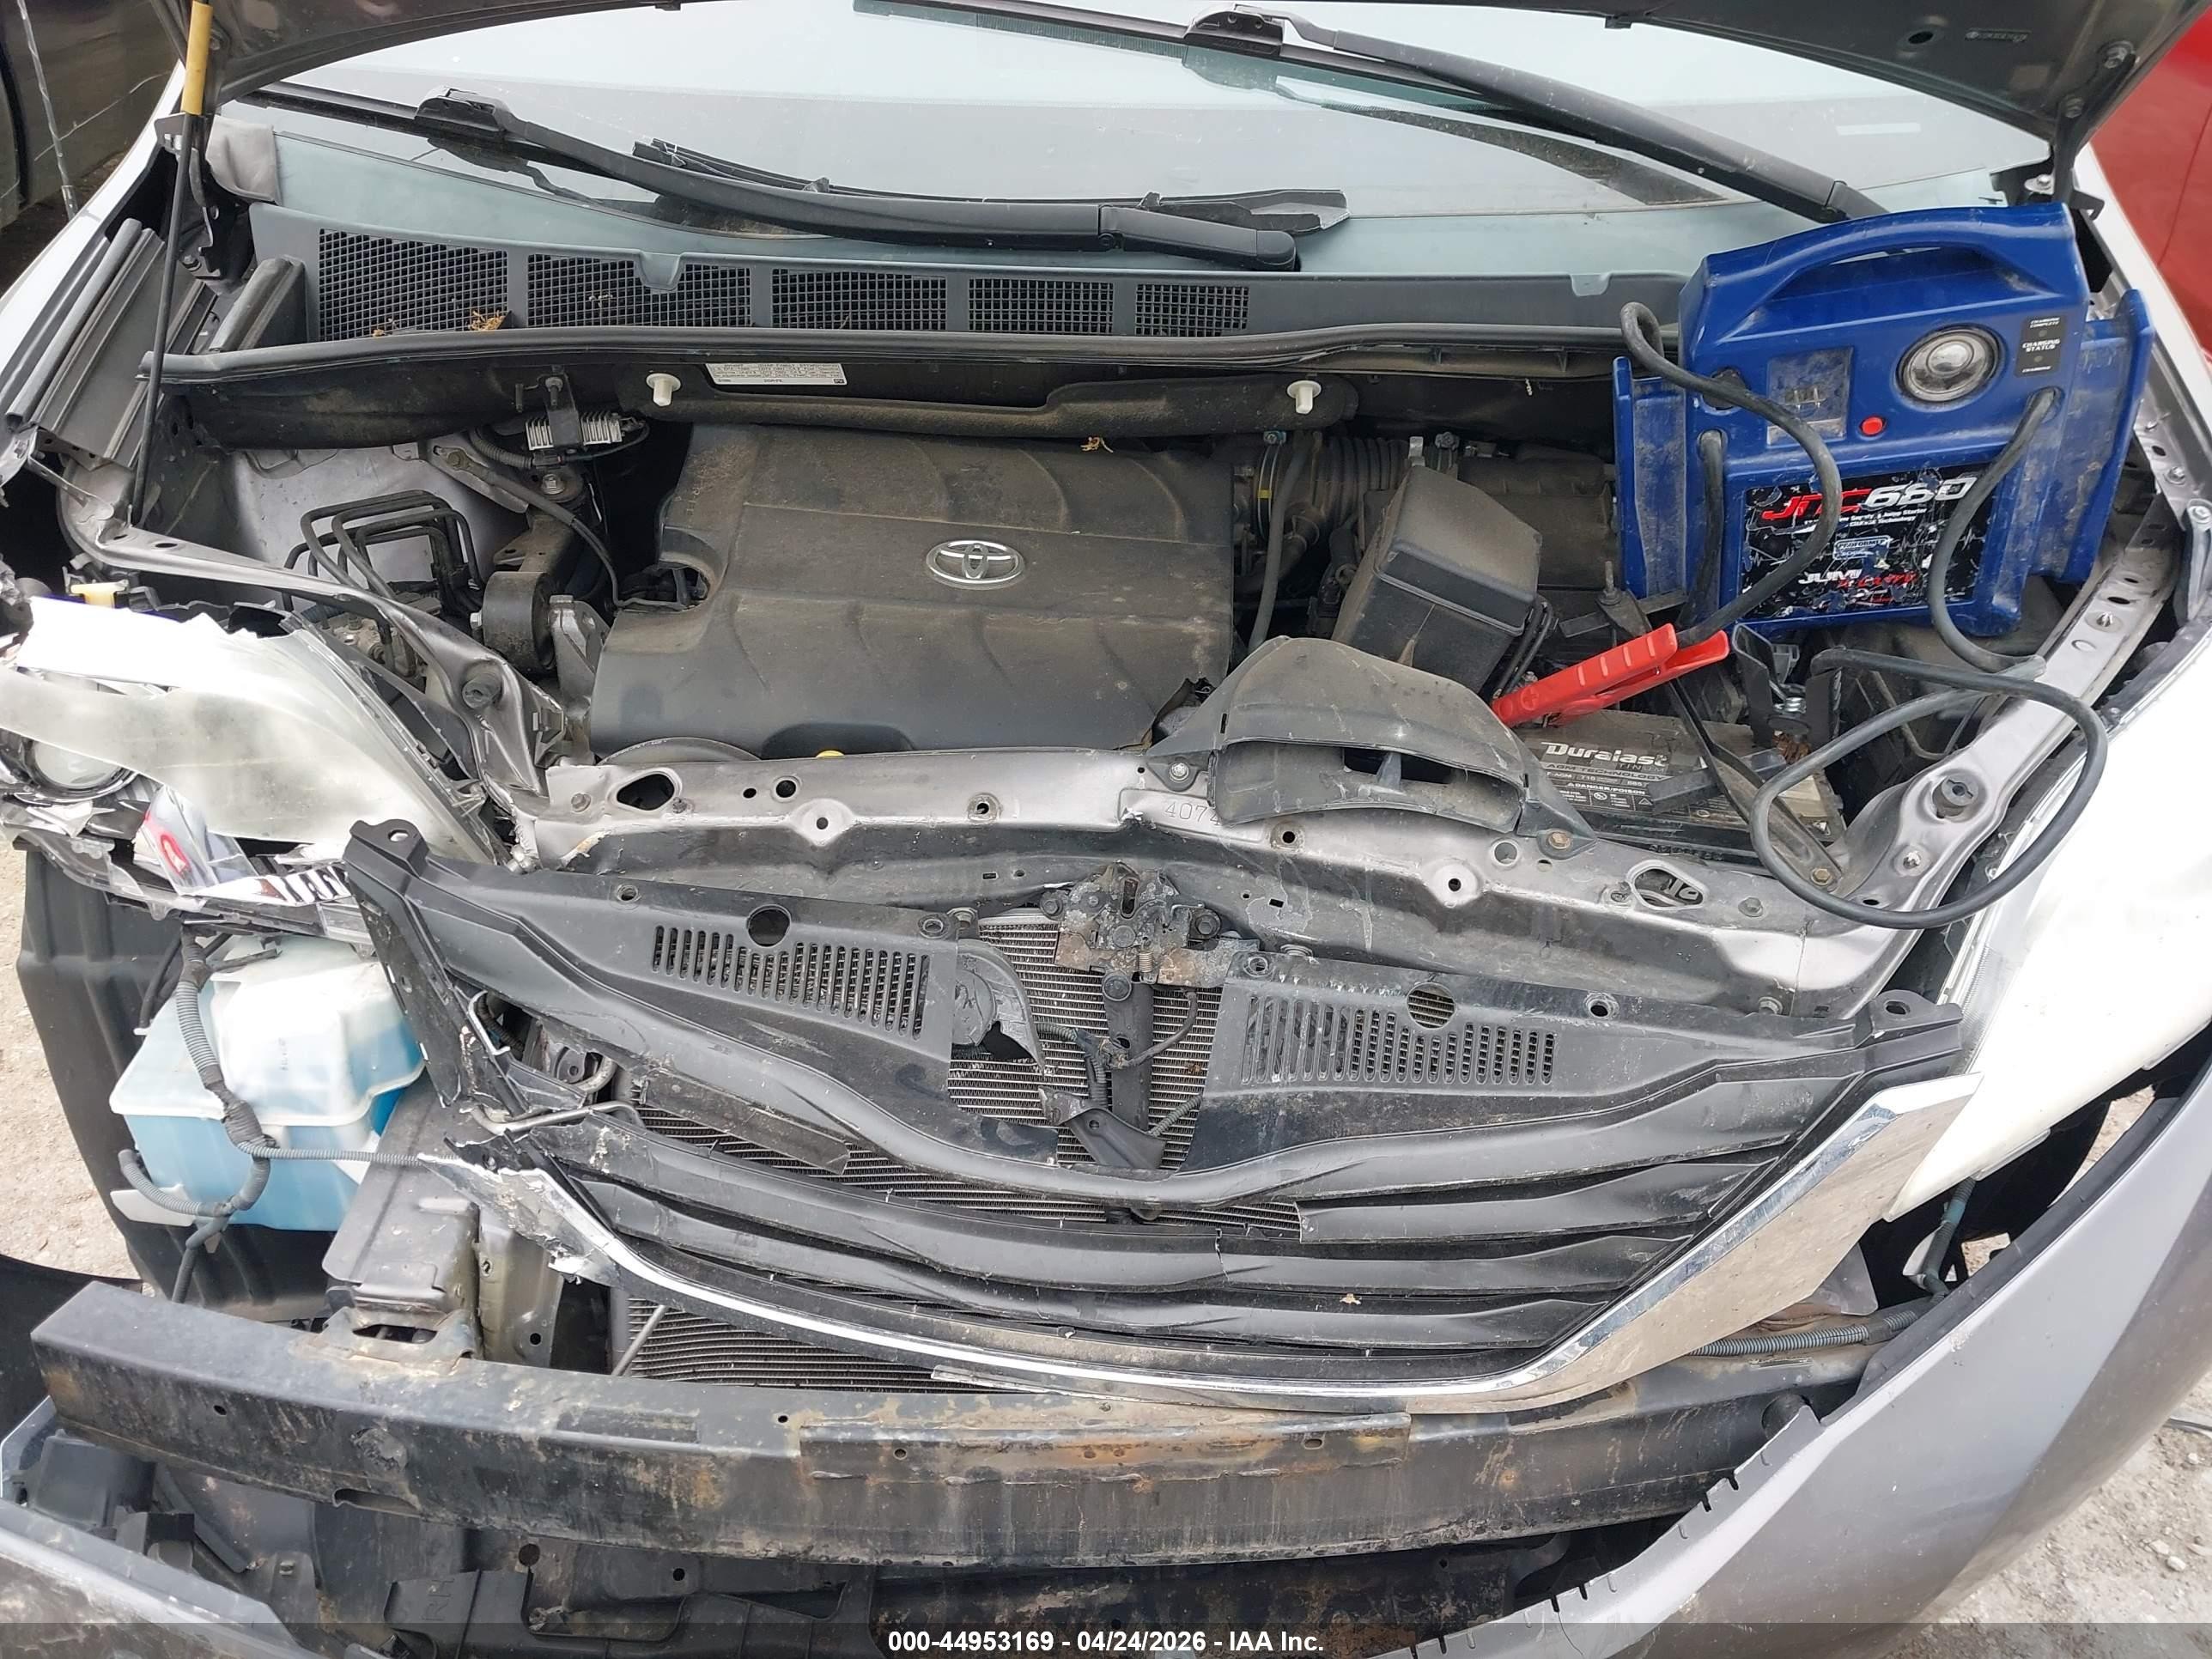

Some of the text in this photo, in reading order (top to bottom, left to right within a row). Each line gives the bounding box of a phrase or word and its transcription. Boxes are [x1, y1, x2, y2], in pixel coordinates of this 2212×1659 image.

[2022, 339, 2060, 349] CHARGING
[1903, 507, 1928, 516] Starter
[1878, 515, 1917, 524] Technology
[1541, 741, 1668, 768] Duralast
[1580, 766, 1667, 781] TECHNOLOGY
[1576, 782, 1646, 796] DANGER/POISON
